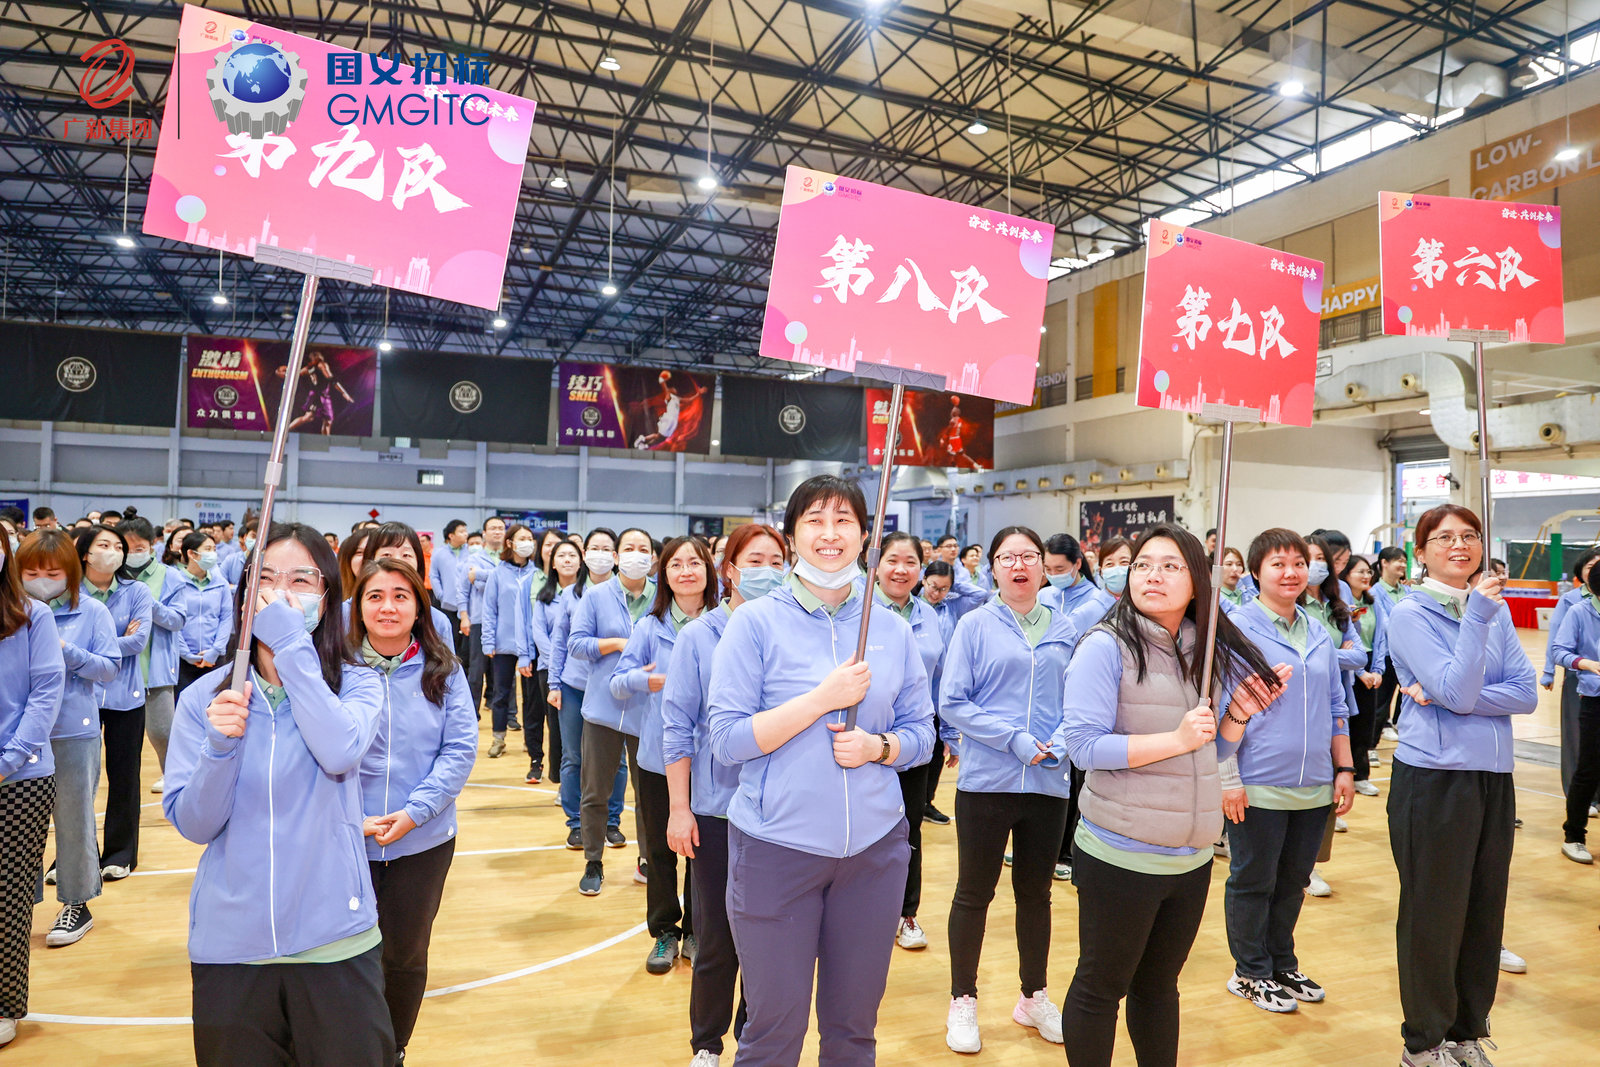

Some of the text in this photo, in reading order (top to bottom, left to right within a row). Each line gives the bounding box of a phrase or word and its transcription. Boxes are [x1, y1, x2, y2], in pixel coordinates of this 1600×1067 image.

[1476, 134, 1542, 170] LOW-
[813, 233, 1011, 325] 第八队
[1410, 236, 1541, 292] 第六队
[1321, 283, 1379, 314] HAPPY
[1171, 284, 1300, 361] 第七队
[191, 368, 249, 380] ENTHUSIASM
[198, 349, 242, 369] 激情
[567, 374, 604, 391] 技巧
[568, 390, 599, 403] SKILL
